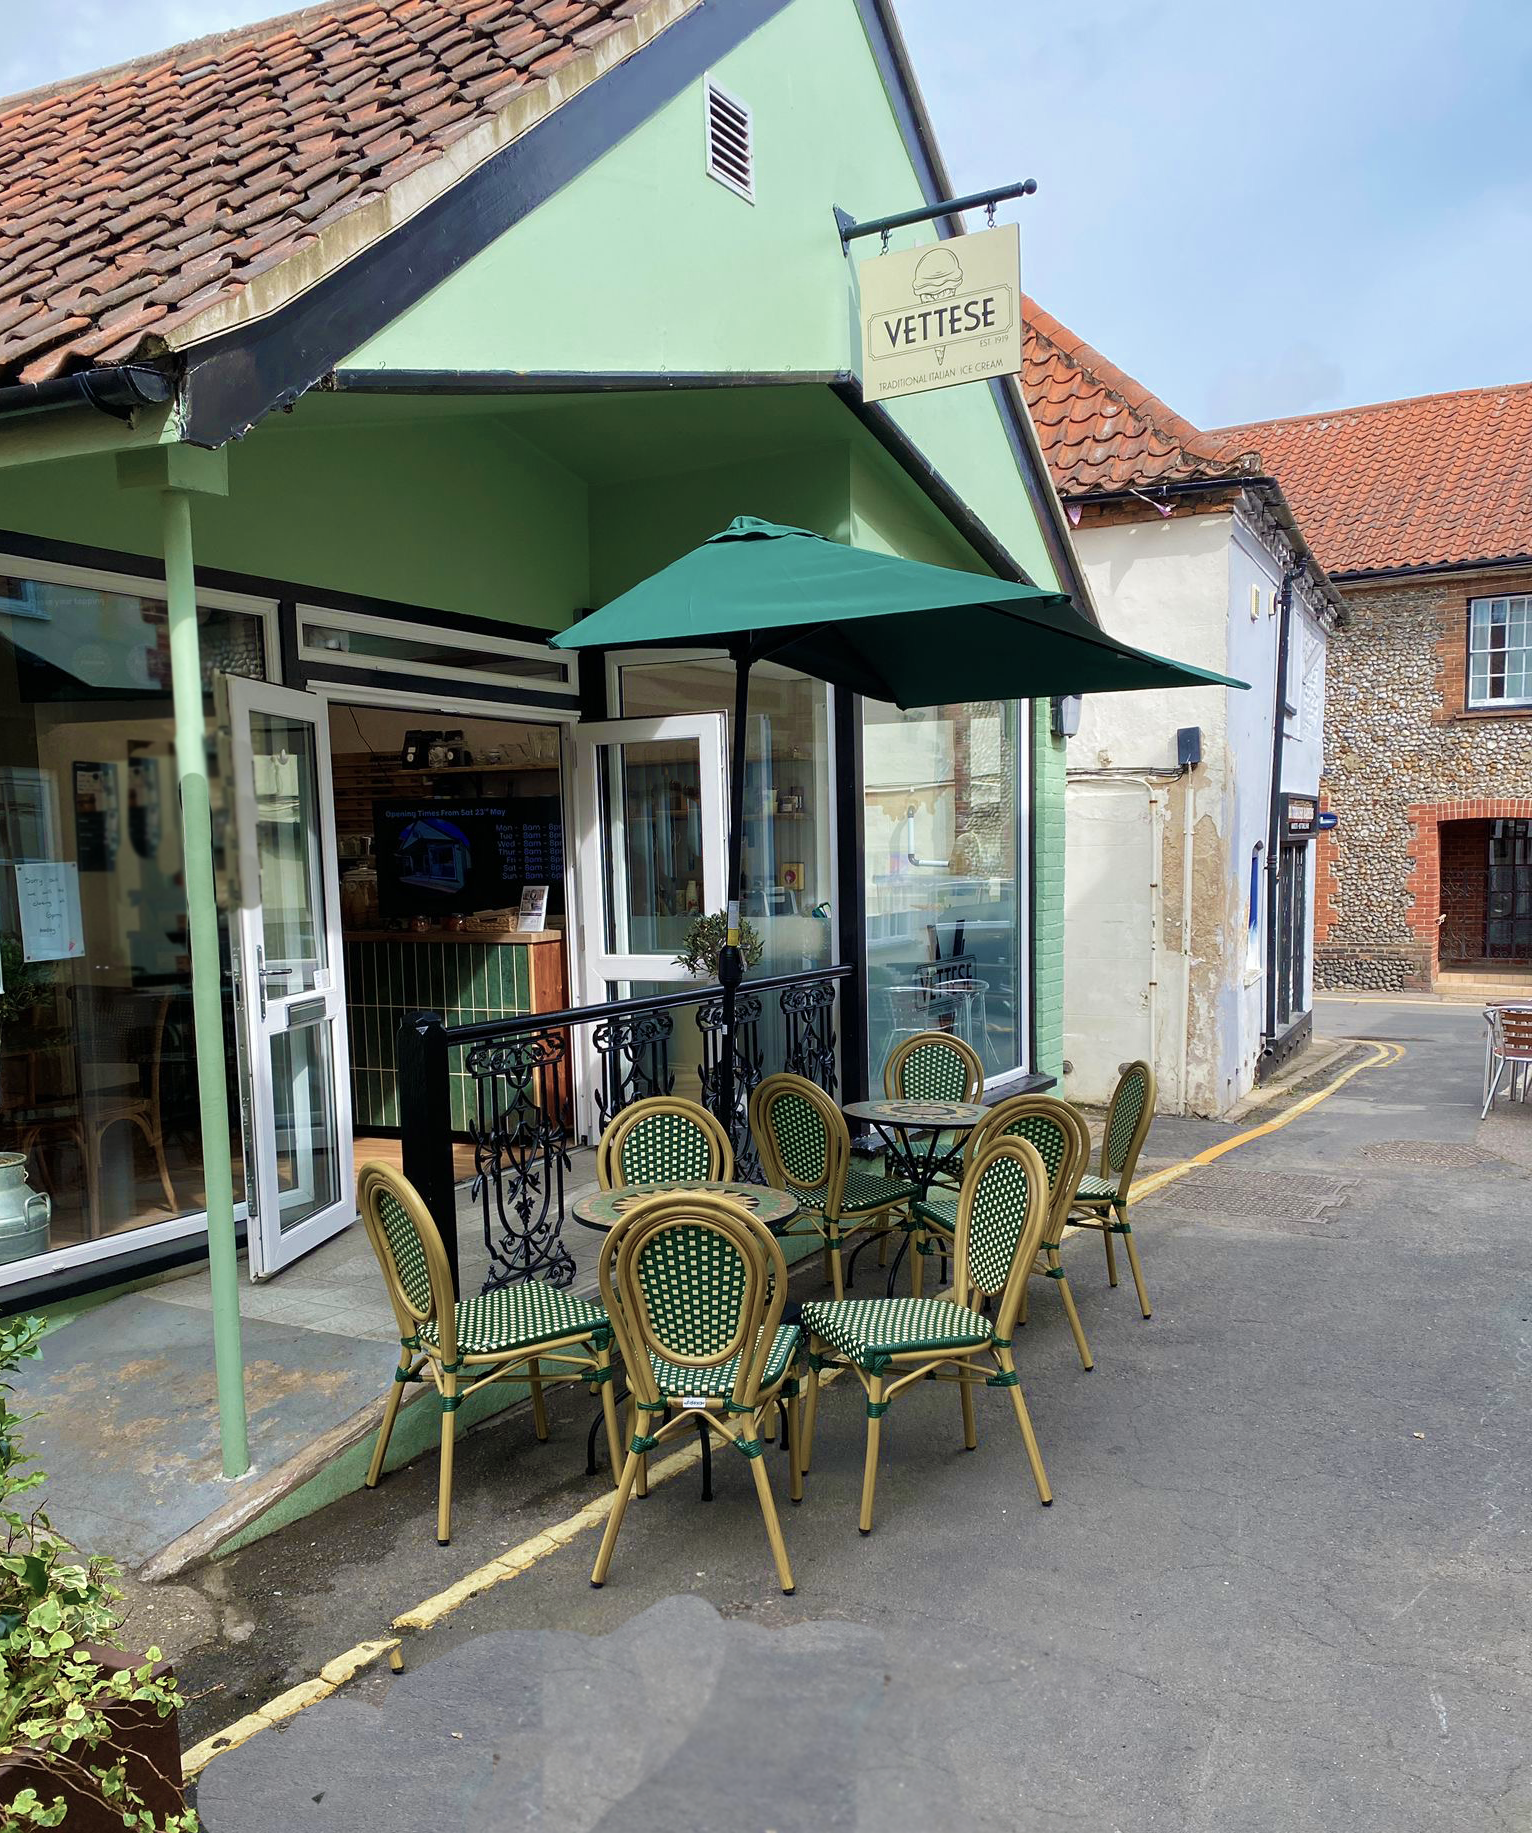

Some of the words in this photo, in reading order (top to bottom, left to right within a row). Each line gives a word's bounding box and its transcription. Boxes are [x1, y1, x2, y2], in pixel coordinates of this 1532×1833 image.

[884, 297, 995, 348] VETTESE
[879, 376, 926, 391] TRADITIONAL
[928, 369, 956, 382] ITALIAN
[960, 365, 973, 374] ICE
[975, 359, 1003, 372] CREAM
[385, 810, 417, 819] Opening
[418, 809, 440, 817] Times
[441, 809, 460, 817] From
[460, 808, 474, 816] Sat
[490, 808, 506, 818] May
